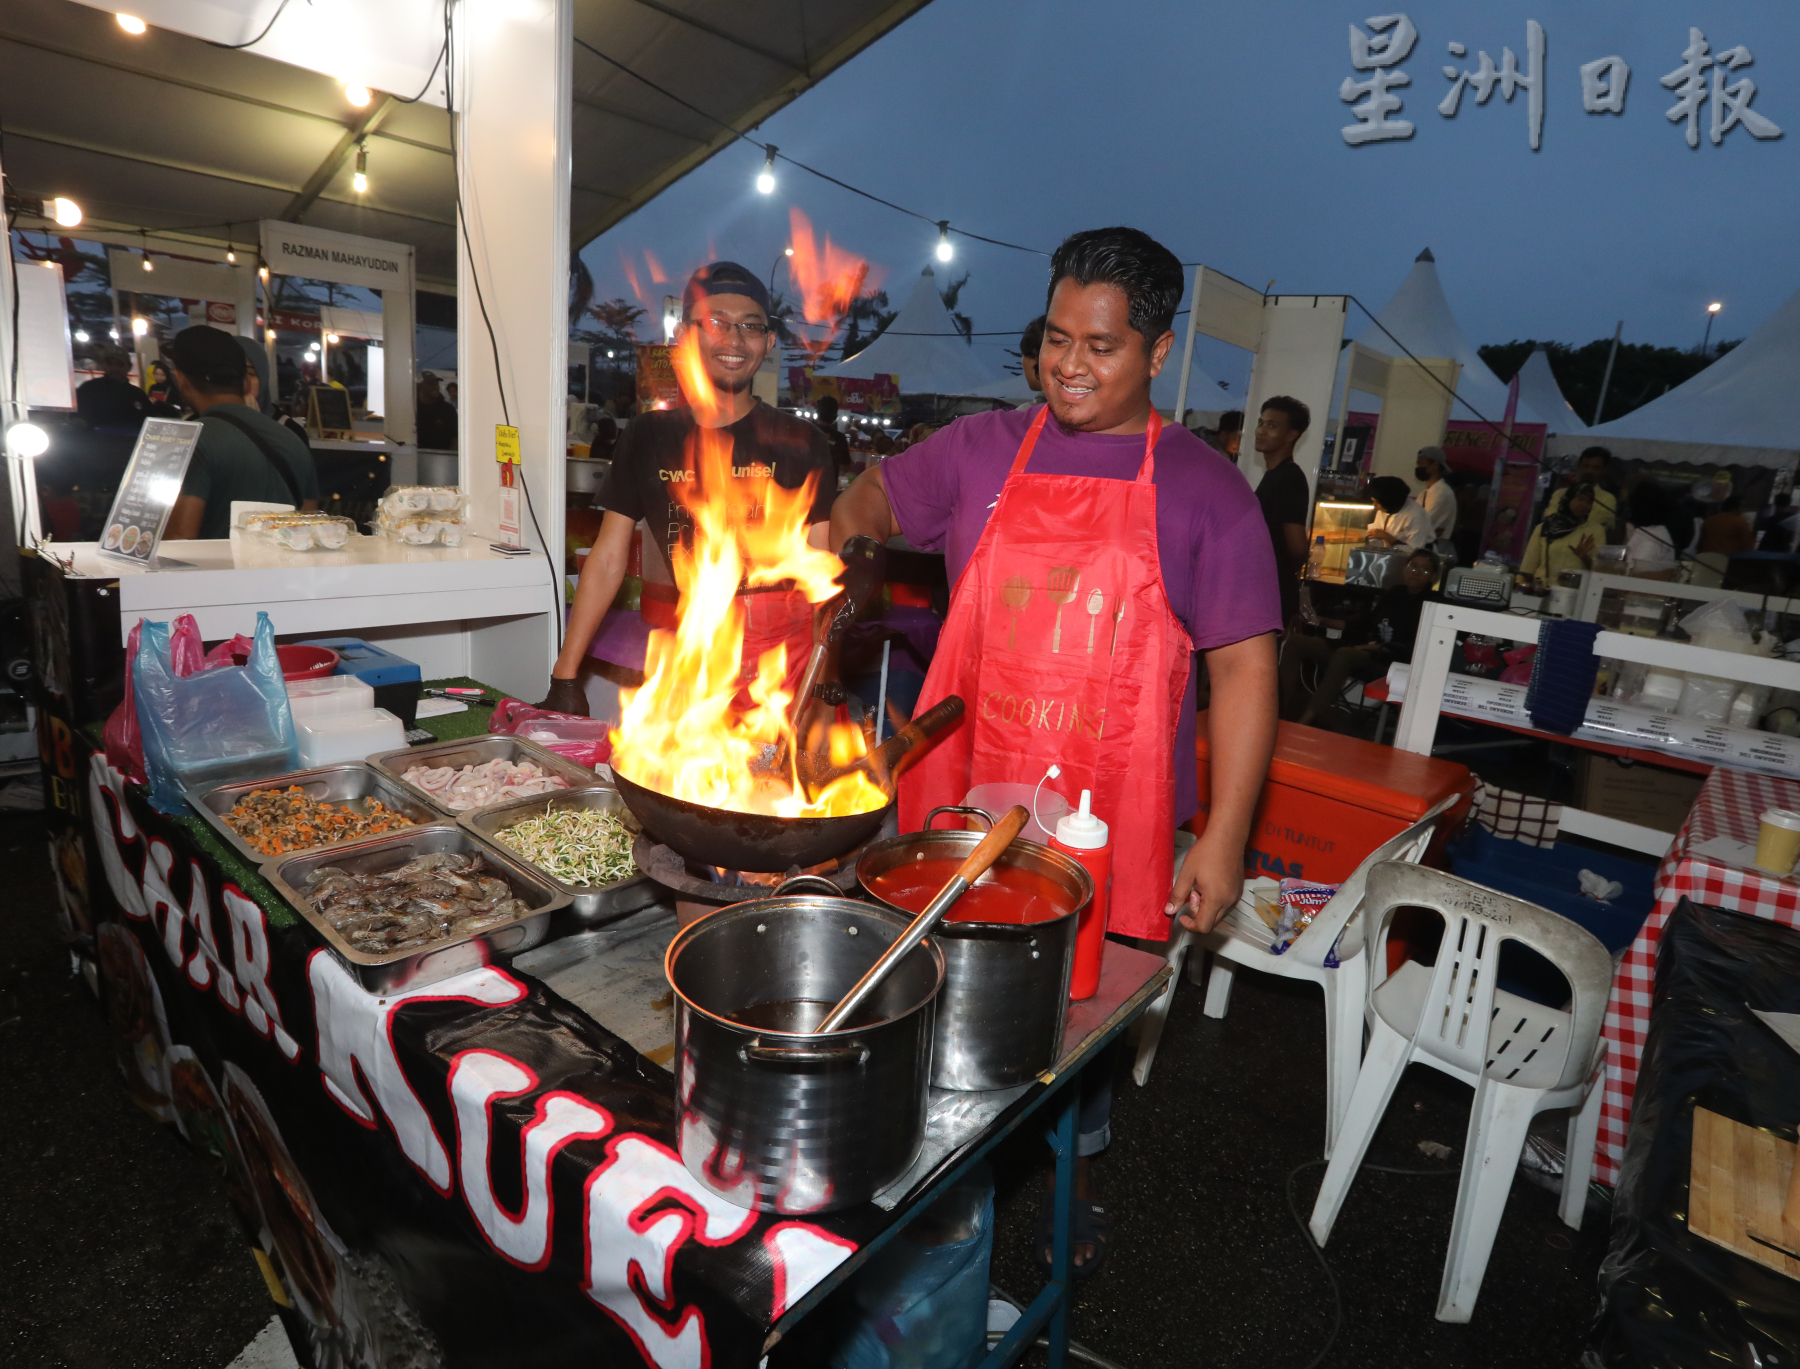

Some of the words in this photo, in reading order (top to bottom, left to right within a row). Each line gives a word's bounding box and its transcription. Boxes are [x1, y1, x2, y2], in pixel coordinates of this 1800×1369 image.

[282, 242, 329, 261] RAZMAN
[331, 250, 398, 273] MAHAYUDDIN
[731, 461, 777, 478] unisel
[982, 691, 1109, 741] COOKING
[1284, 827, 1337, 853] TUNTUT
[1244, 848, 1304, 879] TLAS
